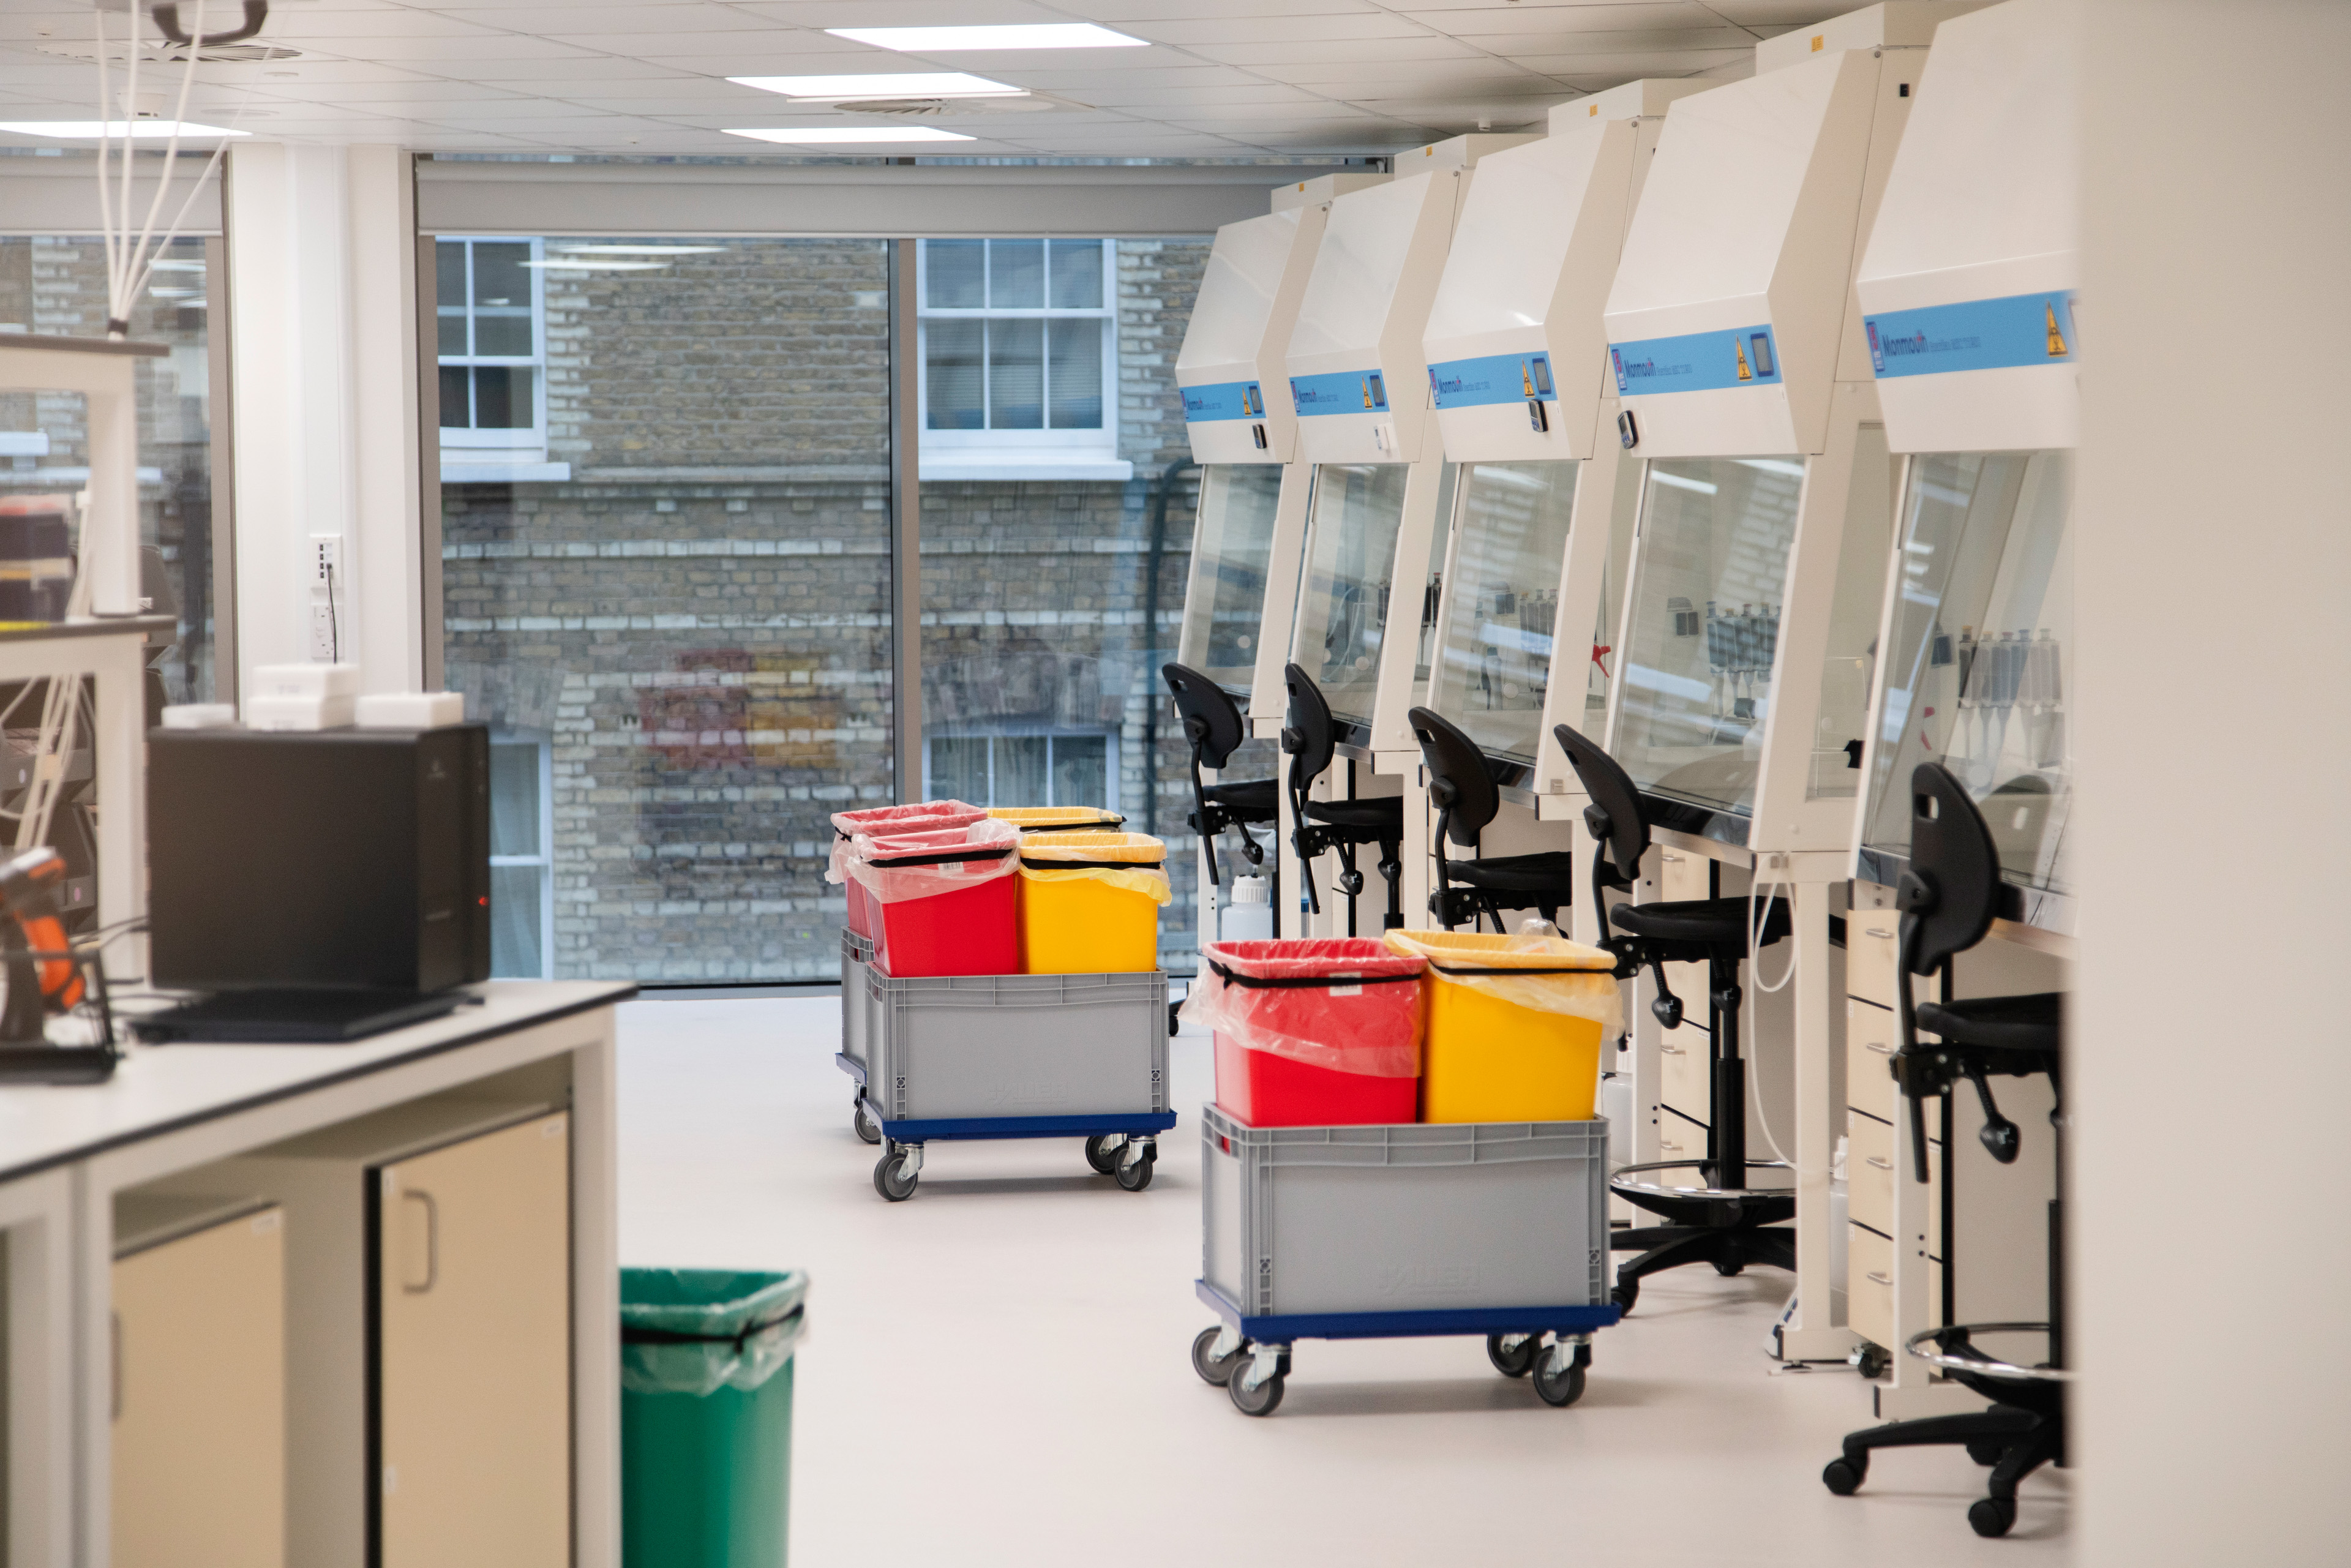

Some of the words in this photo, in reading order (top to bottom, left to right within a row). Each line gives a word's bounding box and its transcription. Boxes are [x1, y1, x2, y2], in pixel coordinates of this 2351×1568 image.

[1882, 329, 1929, 357] Monmouth
[1624, 357, 1657, 378] Monmouth
[1438, 375, 1464, 395] Monmouth
